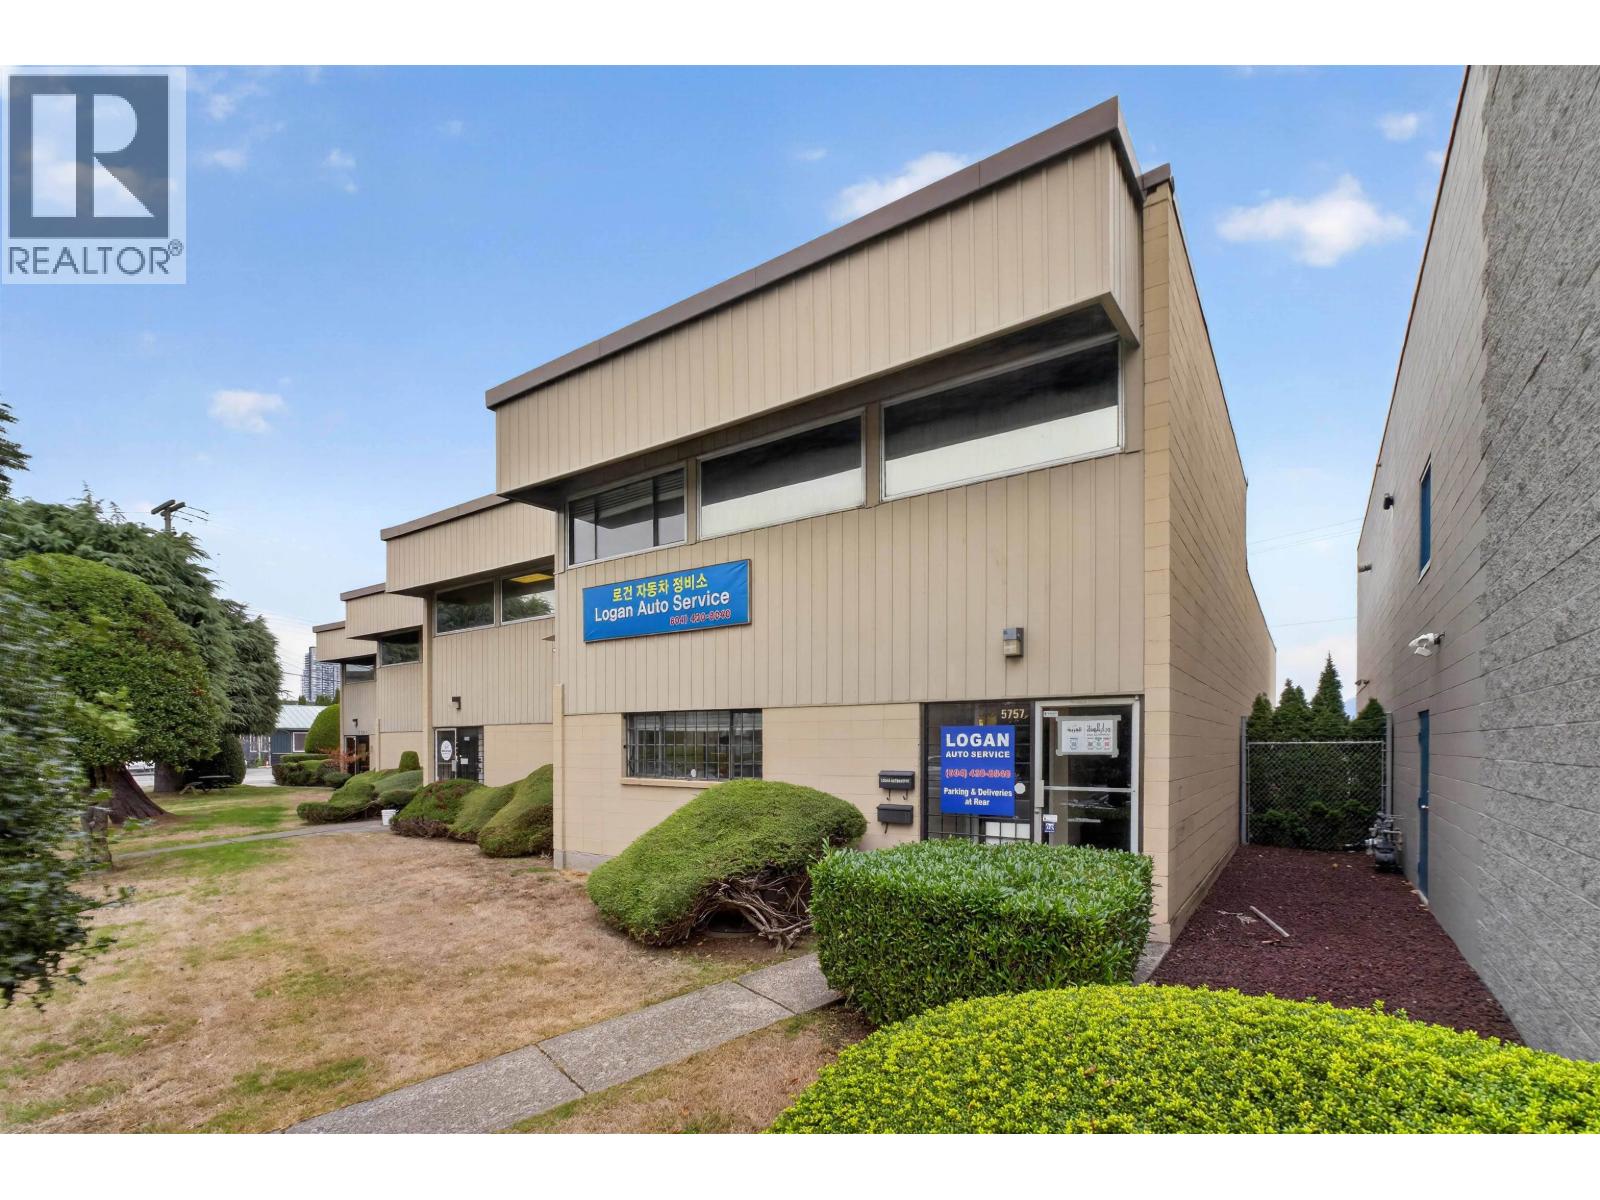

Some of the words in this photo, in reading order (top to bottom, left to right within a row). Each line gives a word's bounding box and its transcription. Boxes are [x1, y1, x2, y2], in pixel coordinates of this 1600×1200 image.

[612, 585, 633, 602] 로건
[636, 579, 669, 598] 자동차
[673, 573, 708, 593] 정비소
[595, 606, 634, 622] Logan
[637, 598, 669, 616] Auto
[673, 590, 730, 611] Service
[1001, 708, 1025, 720] 5757
[945, 733, 1010, 747] LOGAN
[945, 750, 969, 758] AUTO
[971, 750, 1011, 758] SERVICE
[943, 787, 969, 797] Parking
[970, 788, 977, 796] &
[978, 788, 1013, 797] Deliveries
[964, 798, 973, 806] at
[973, 798, 991, 806] Rear
